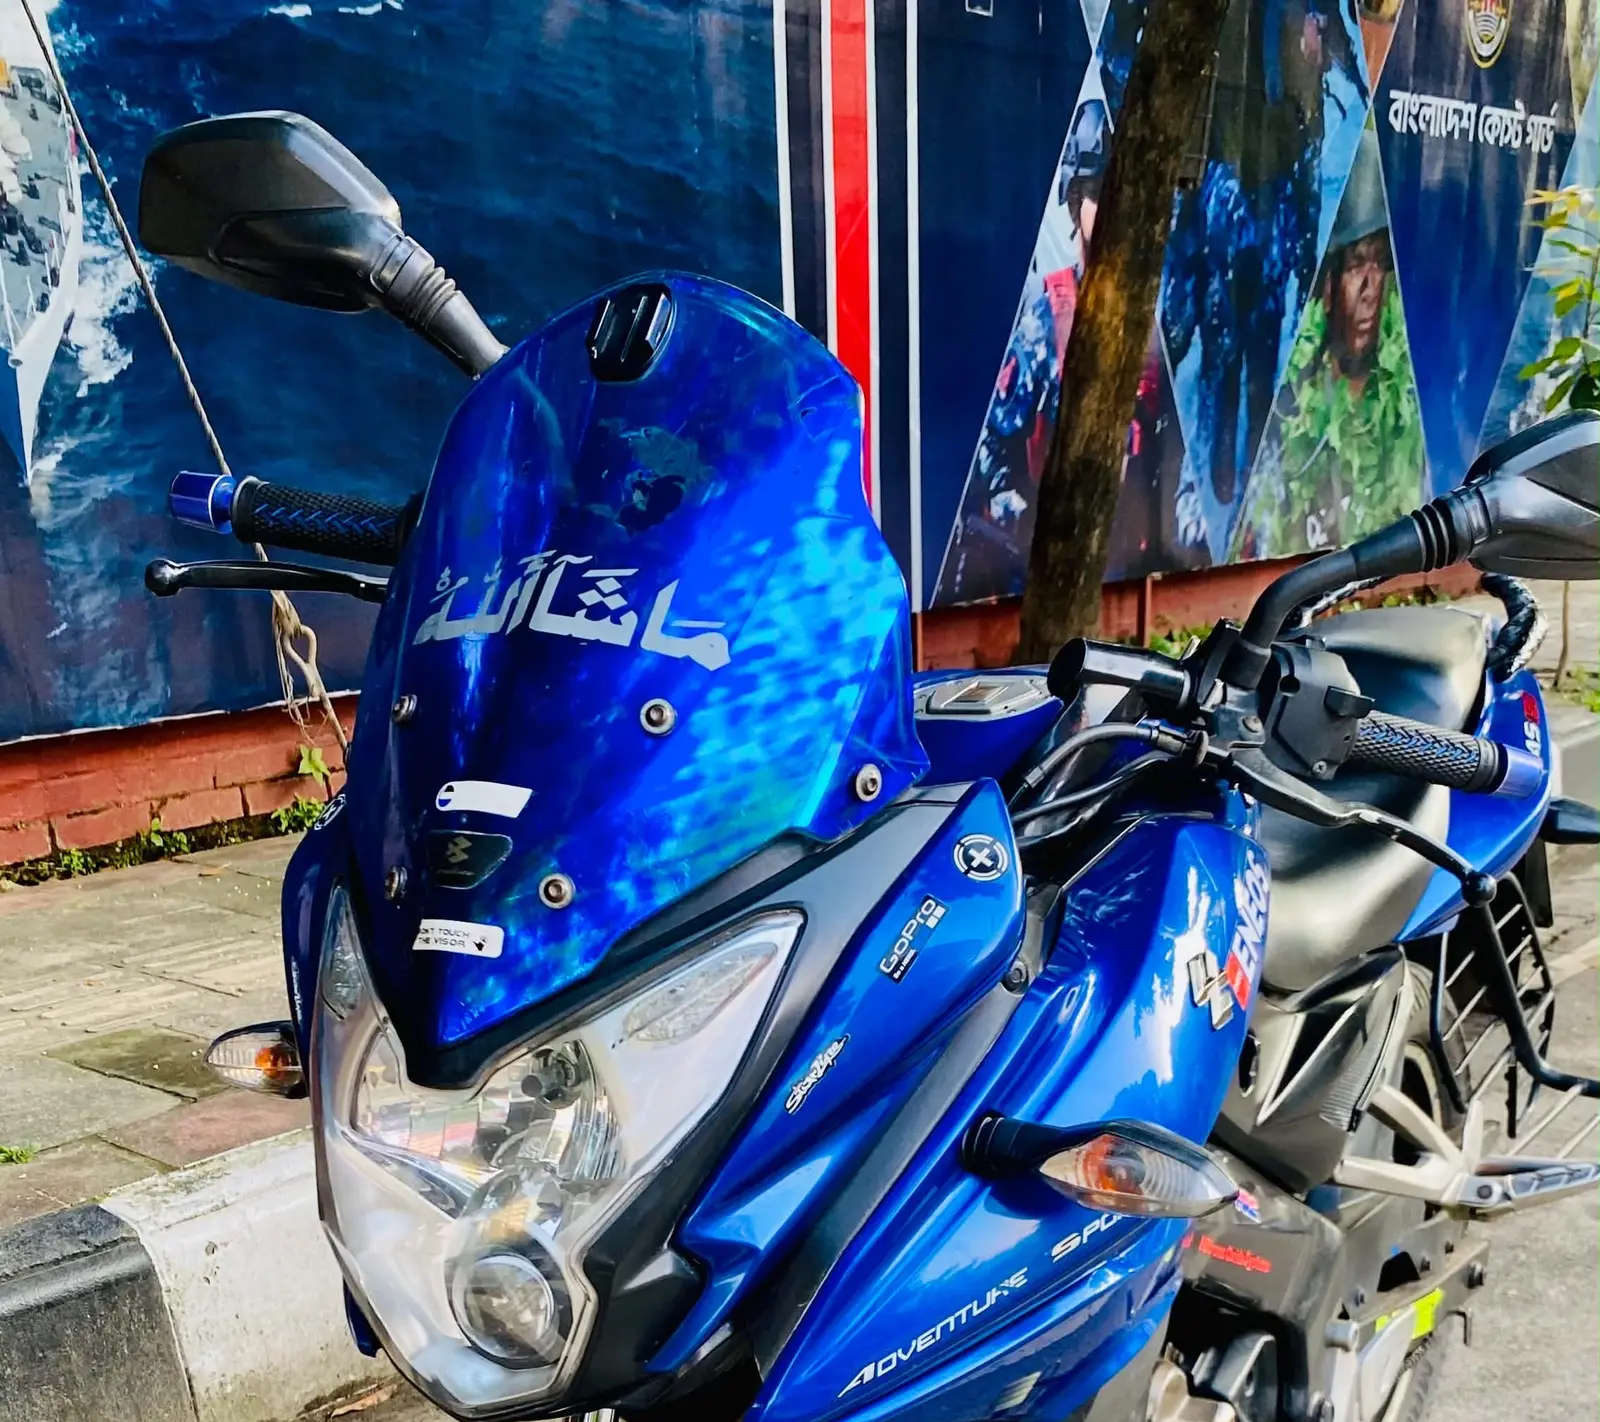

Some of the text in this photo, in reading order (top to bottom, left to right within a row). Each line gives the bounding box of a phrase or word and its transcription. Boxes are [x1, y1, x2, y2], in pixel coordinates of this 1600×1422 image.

[1388, 89, 1477, 142] বাংলাদেশ
[433, 937, 466, 948] VISOR
[438, 928, 470, 938] TOUCH
[879, 899, 936, 973] GoPro
[1231, 846, 1271, 985] ENEOS
[837, 1266, 1028, 1398] ADVENTURE
[1051, 1213, 1122, 1264] SPO
